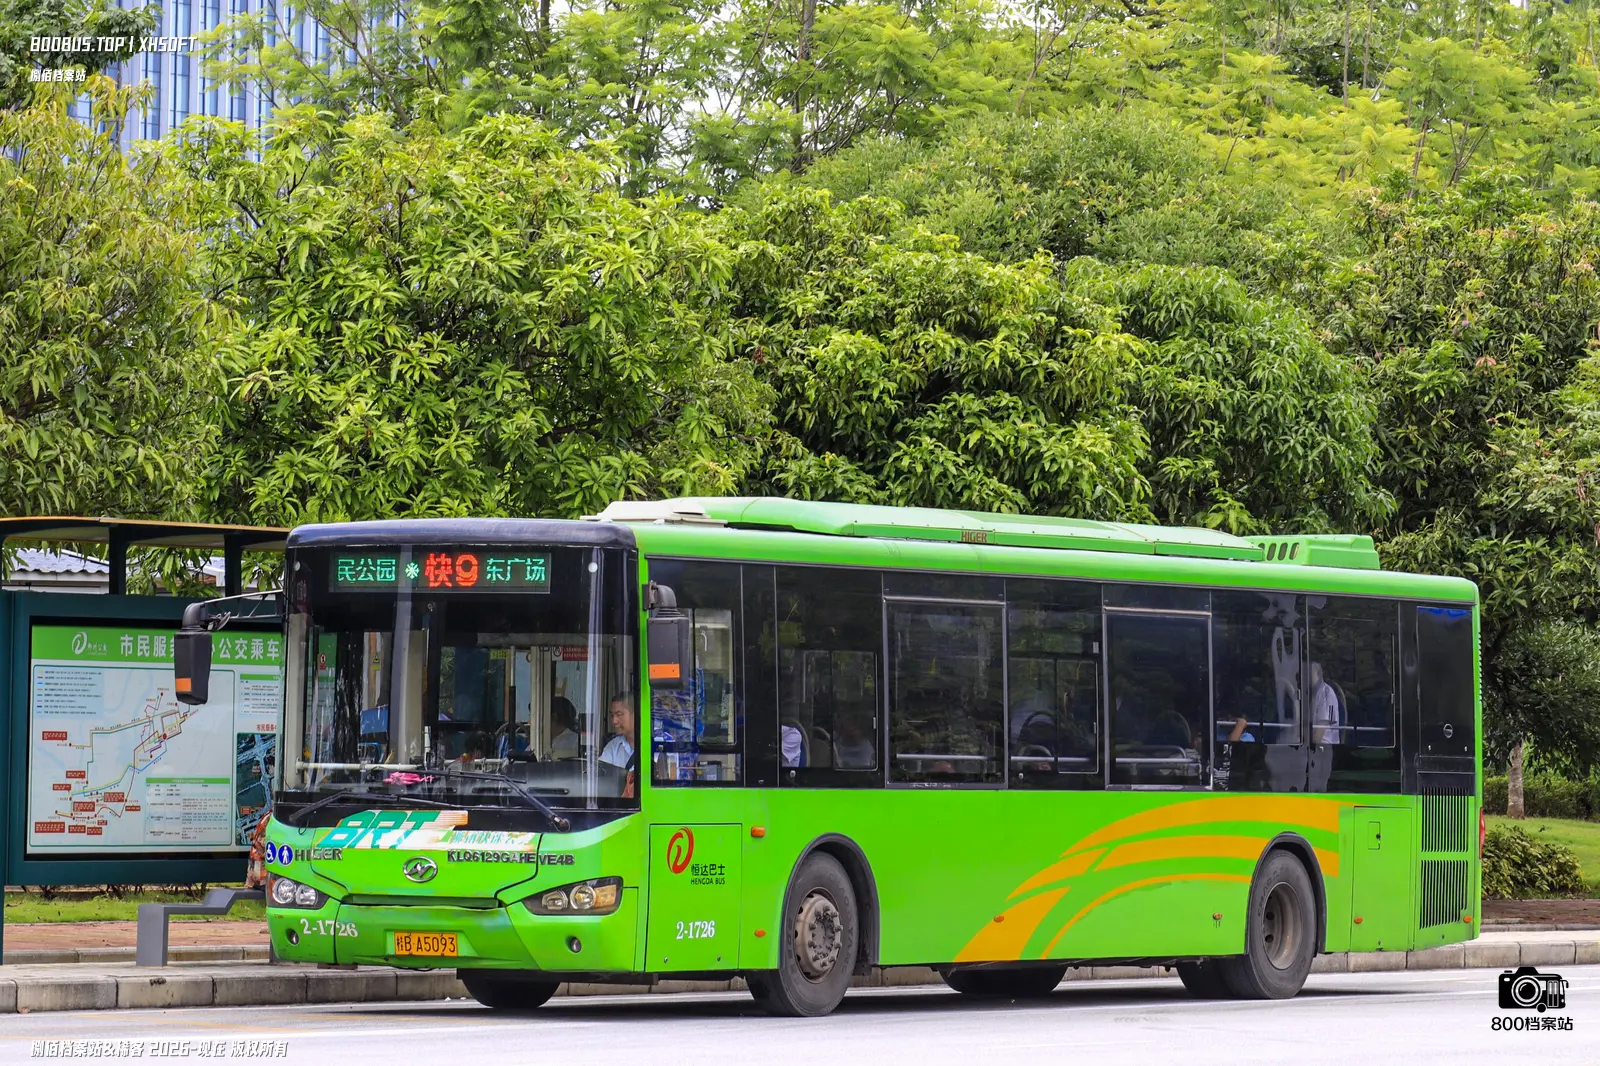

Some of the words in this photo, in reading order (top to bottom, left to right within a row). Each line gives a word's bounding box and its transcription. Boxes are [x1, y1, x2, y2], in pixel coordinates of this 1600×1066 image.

[961, 530, 988, 544] HIGER
[337, 558, 396, 582] 民公园
[424, 552, 479, 588] 快9
[486, 557, 546, 583] 东广场
[119, 633, 280, 661] 市民服公交乘车
[294, 847, 344, 862] HIGER
[691, 863, 726, 877] 恒达巴士
[690, 877, 714, 886] HENGDA
[715, 877, 726, 886] BUS
[300, 918, 359, 938] 2-1726
[675, 919, 716, 940] 2-1726
